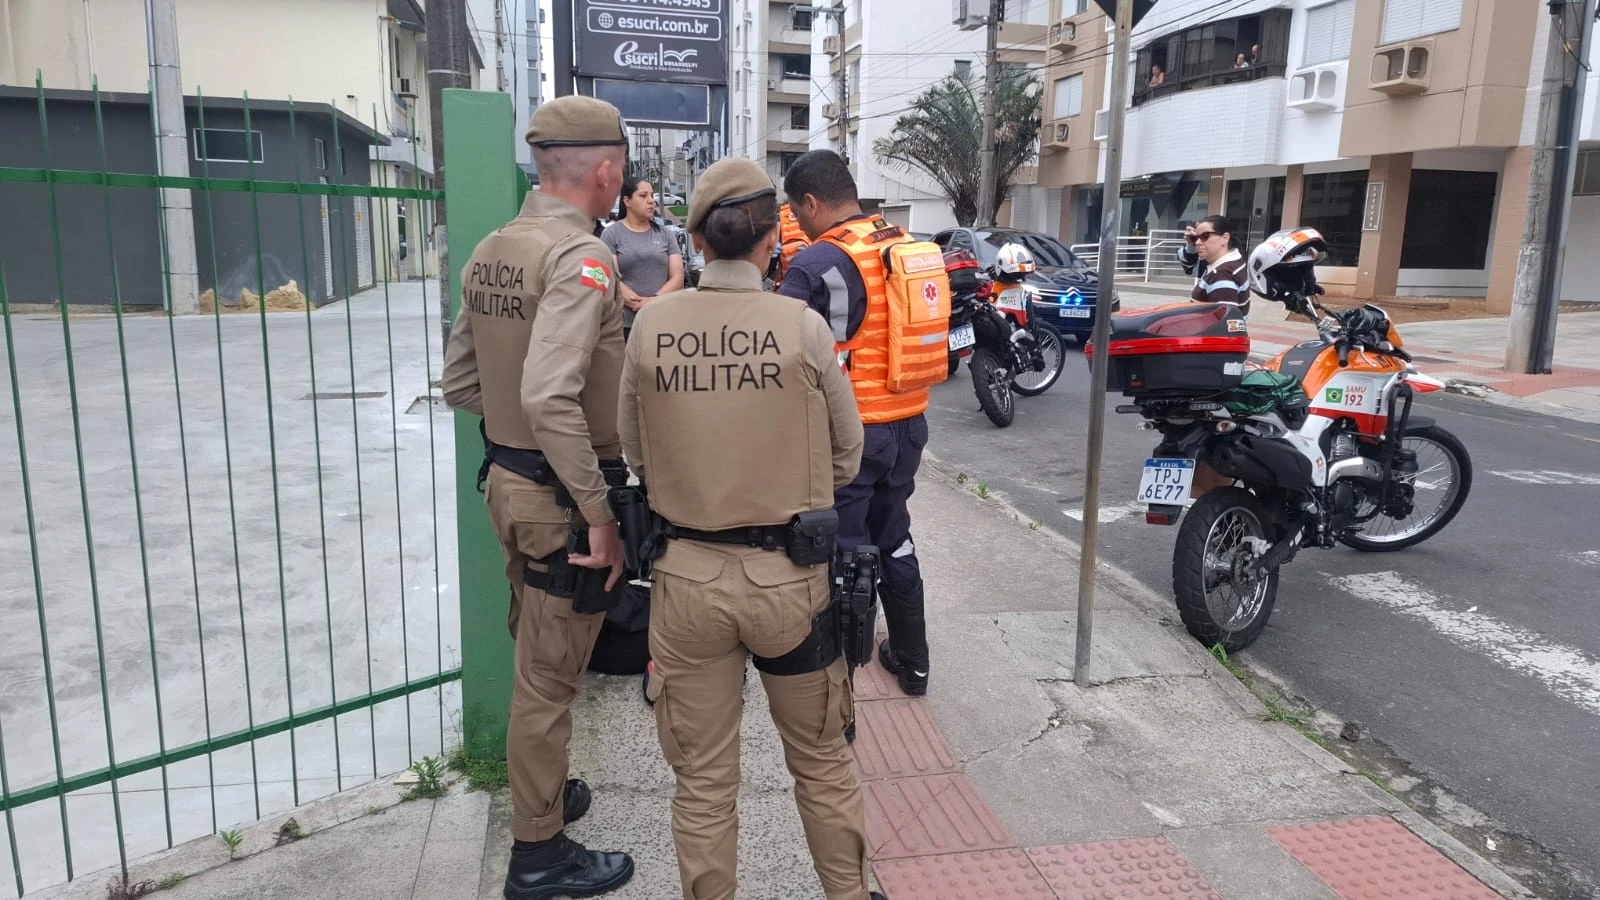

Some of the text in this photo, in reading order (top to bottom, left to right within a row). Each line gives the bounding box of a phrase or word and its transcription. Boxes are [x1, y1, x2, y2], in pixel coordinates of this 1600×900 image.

[618, 17, 709, 34] esucri.com.br
[471, 259, 525, 290] POLÍCIA
[469, 288, 526, 321] MILITAR
[656, 324, 781, 359] POLÍCIA
[655, 362, 784, 393] MILITAR
[1344, 394, 1364, 406] 192
[1154, 468, 1182, 484] TPJ
[1145, 484, 1184, 501] 6E77
